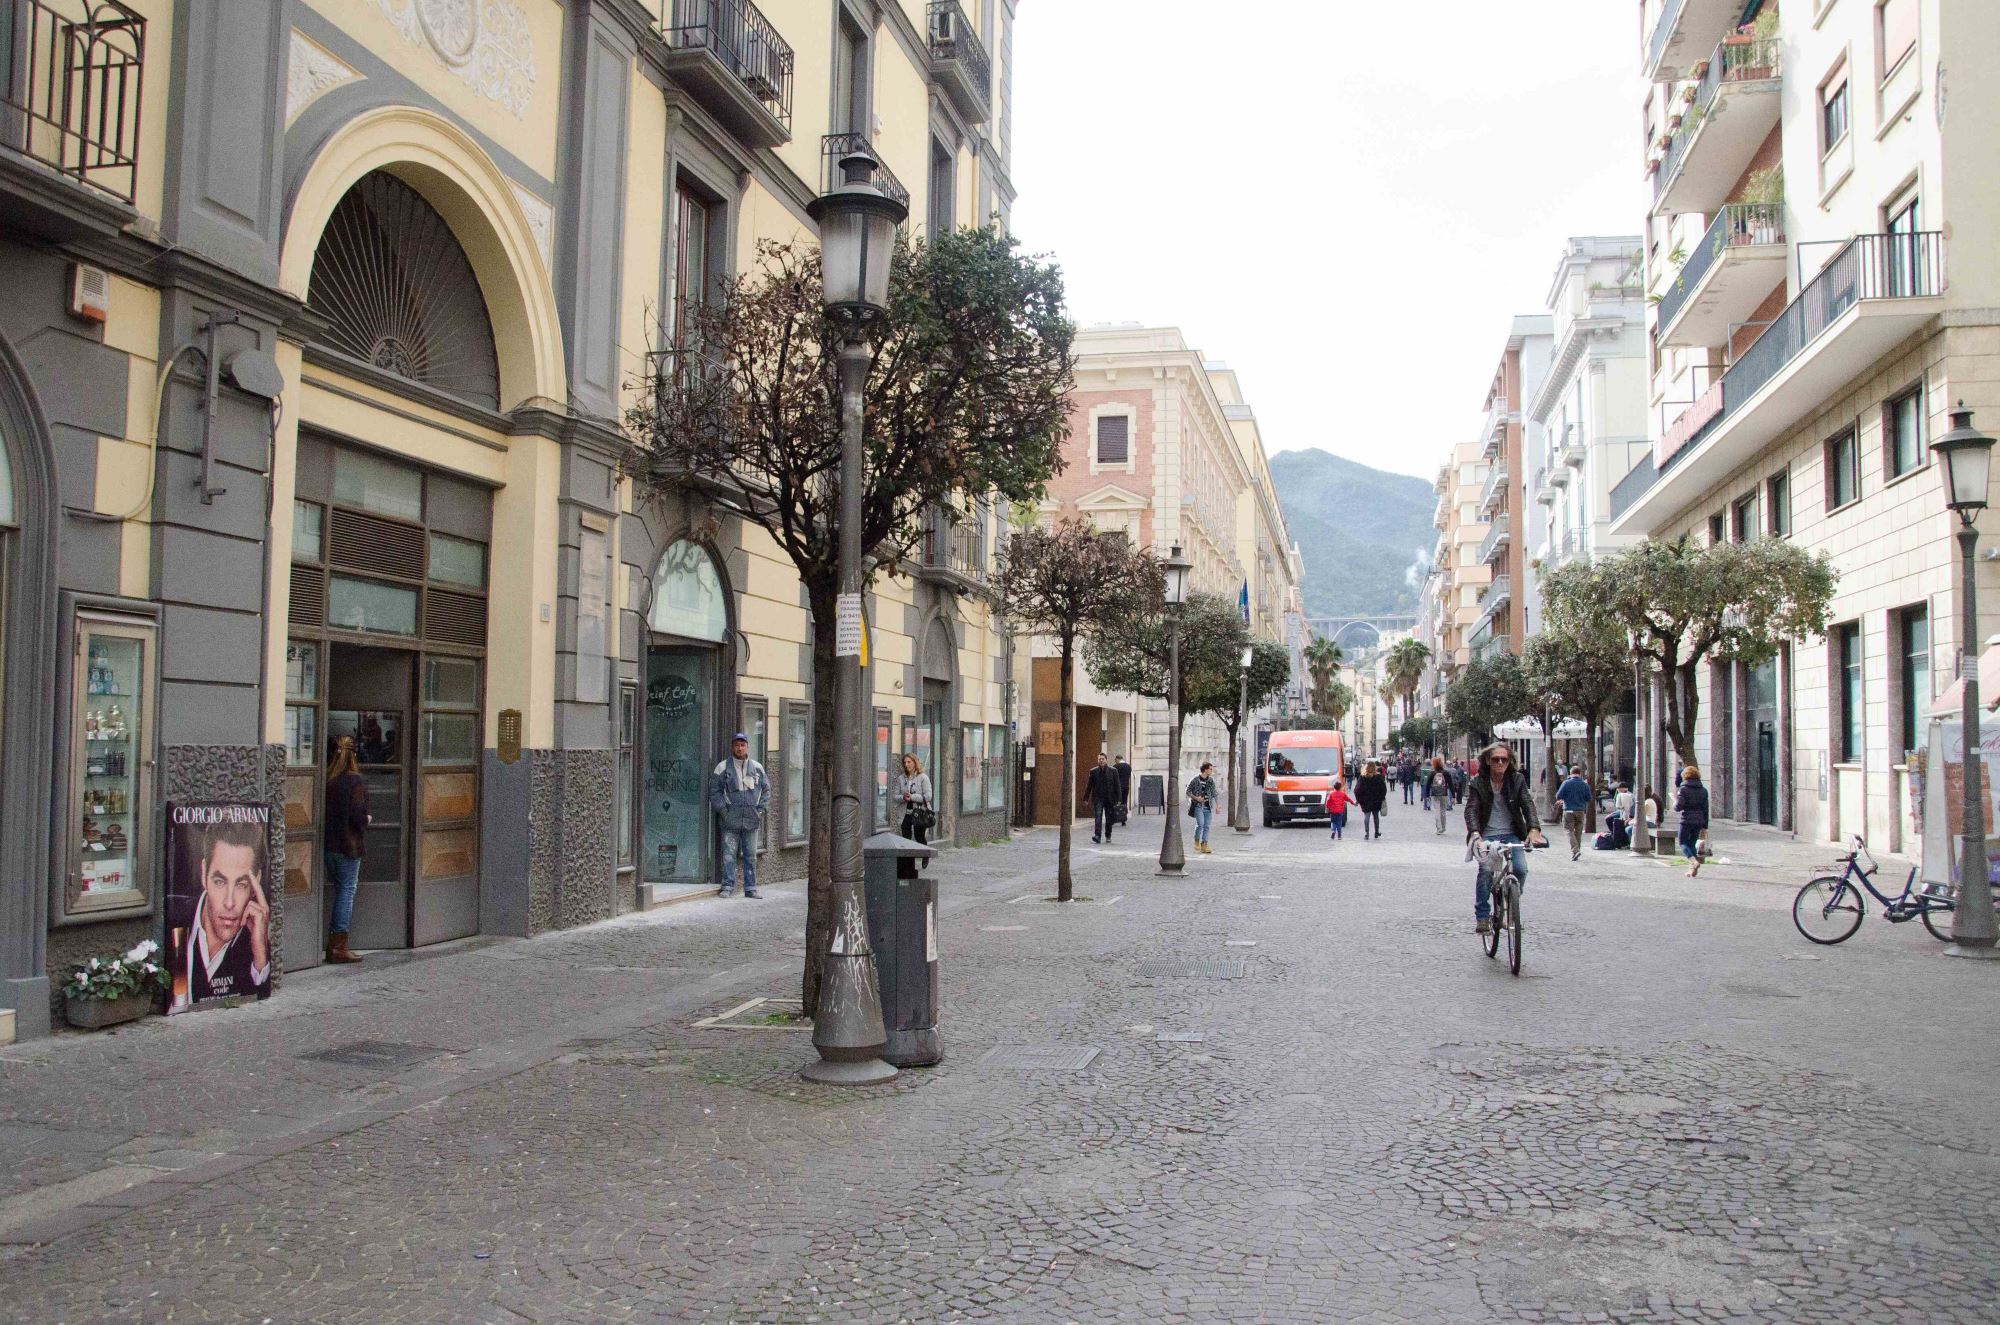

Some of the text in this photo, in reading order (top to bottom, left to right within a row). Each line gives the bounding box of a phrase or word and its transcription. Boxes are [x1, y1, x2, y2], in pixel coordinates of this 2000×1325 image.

[650, 759, 683, 773] NEXT
[173, 806, 269, 824] GIORGIO ARMANI
